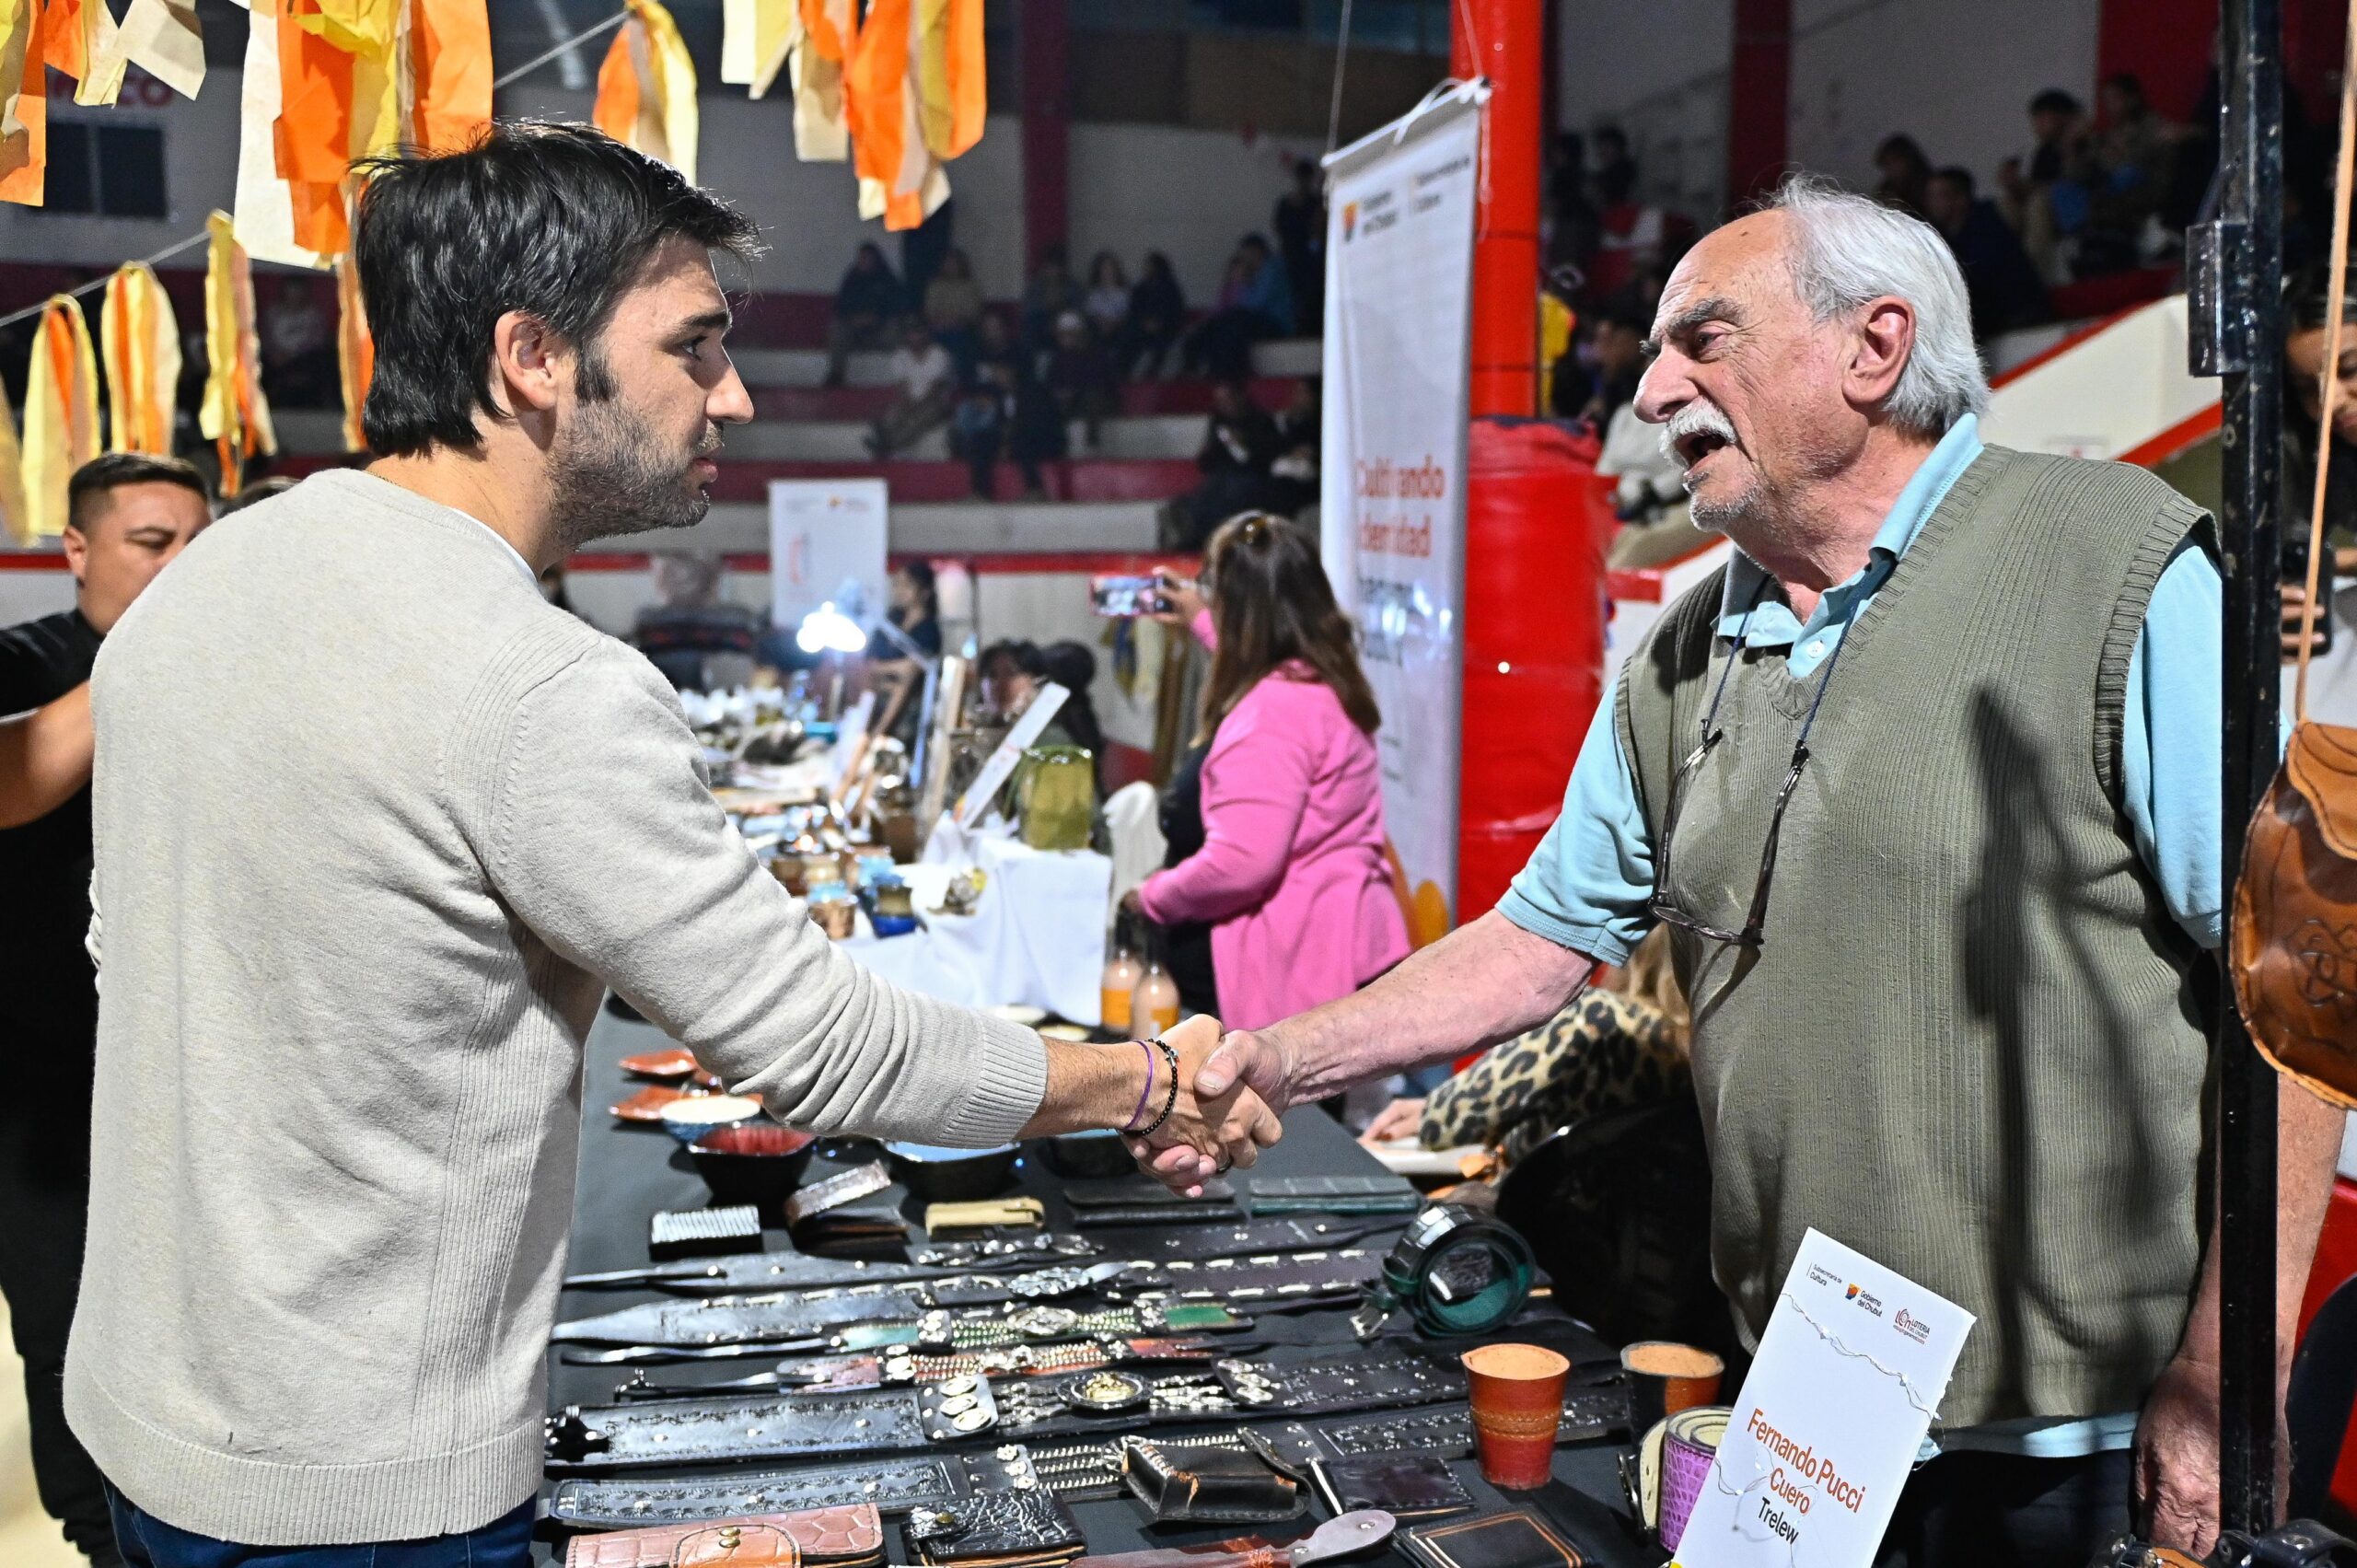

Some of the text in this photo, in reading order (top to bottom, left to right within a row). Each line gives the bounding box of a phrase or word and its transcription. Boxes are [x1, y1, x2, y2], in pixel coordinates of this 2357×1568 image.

[1809, 1272, 1828, 1286] Cultura
[1857, 1299, 1883, 1318] del Chubut
[1860, 1290, 1882, 1307] Gobierno
[1747, 1409, 1866, 1513] Fernando Pucci
[1770, 1468, 1811, 1515] Cuero
[1758, 1497, 1799, 1545] Trelew
